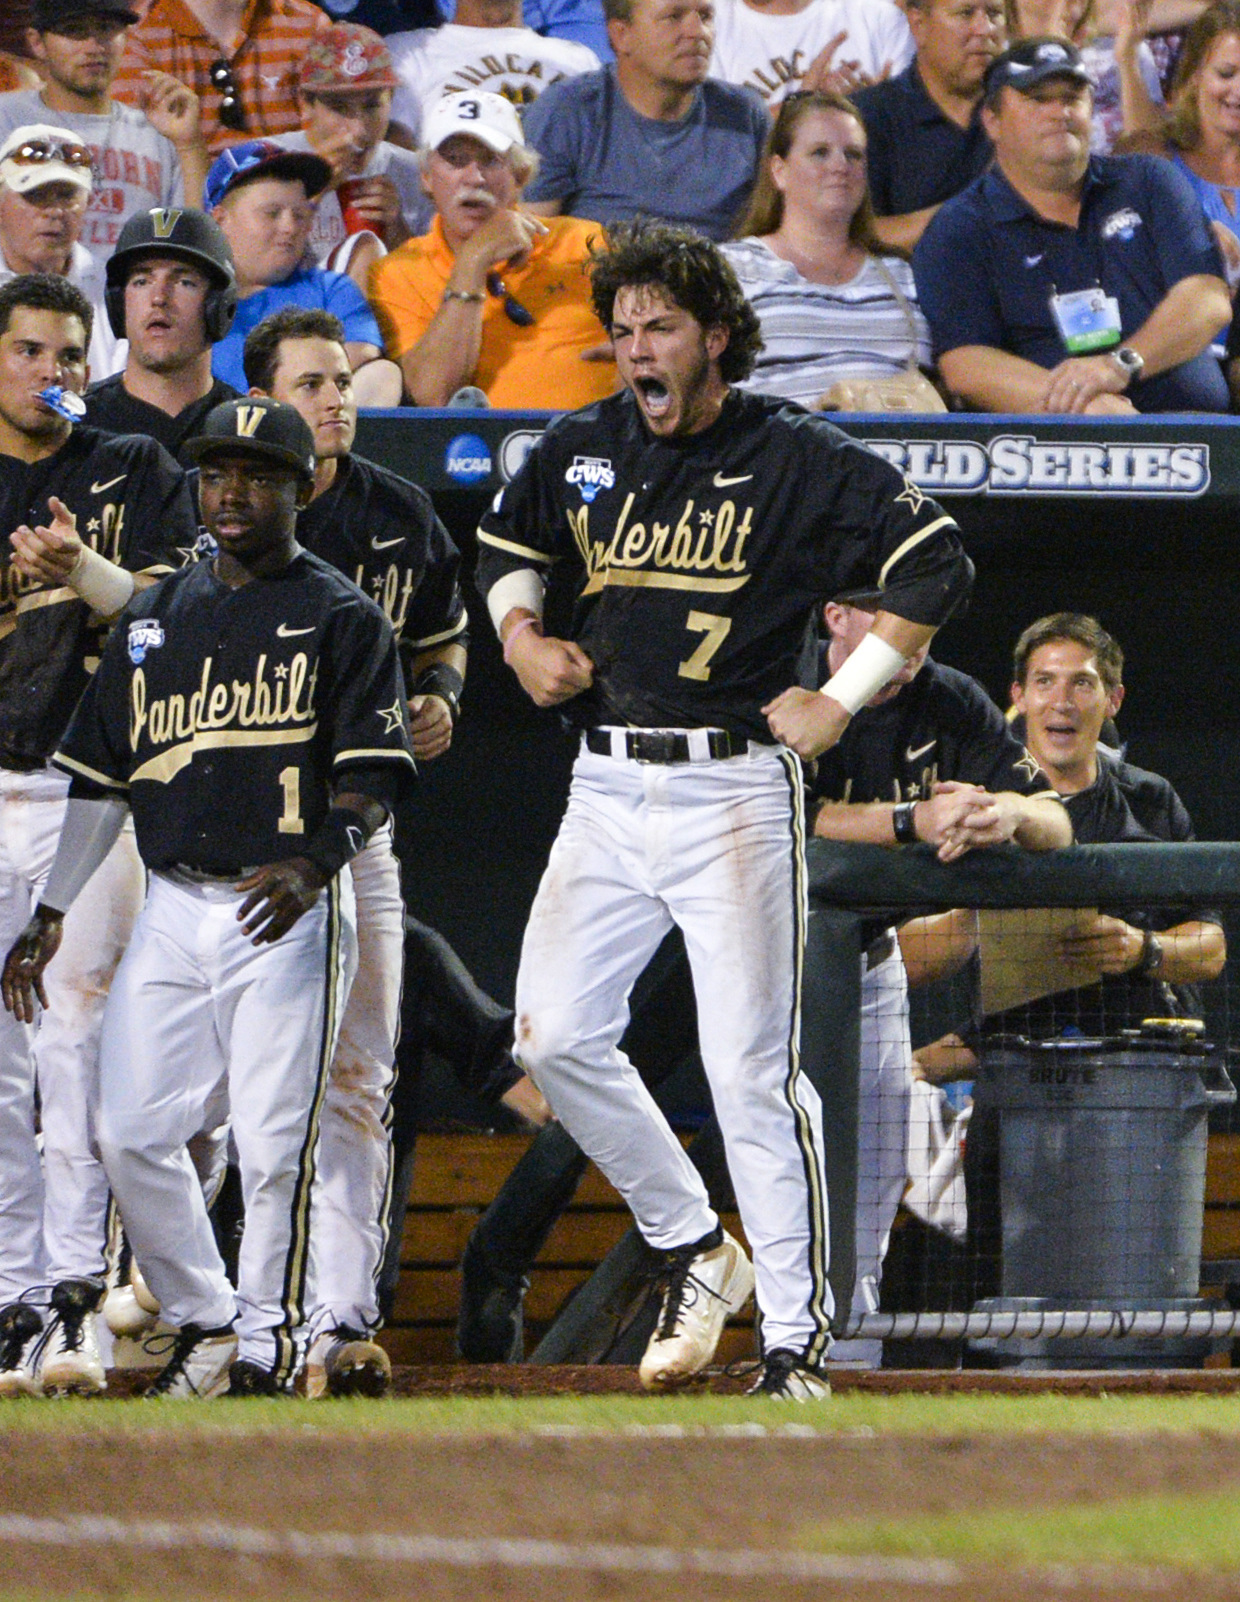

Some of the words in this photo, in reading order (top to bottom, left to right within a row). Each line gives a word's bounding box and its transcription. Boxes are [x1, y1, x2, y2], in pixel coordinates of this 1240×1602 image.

[458, 101, 480, 119] 3
[150, 208, 183, 238] V
[236, 406, 267, 438] V
[446, 457, 492, 473] NCAA
[565, 464, 616, 489] CWS
[988, 437, 1205, 491] SERIES
[677, 609, 732, 681] 7
[278, 766, 304, 834] 1
